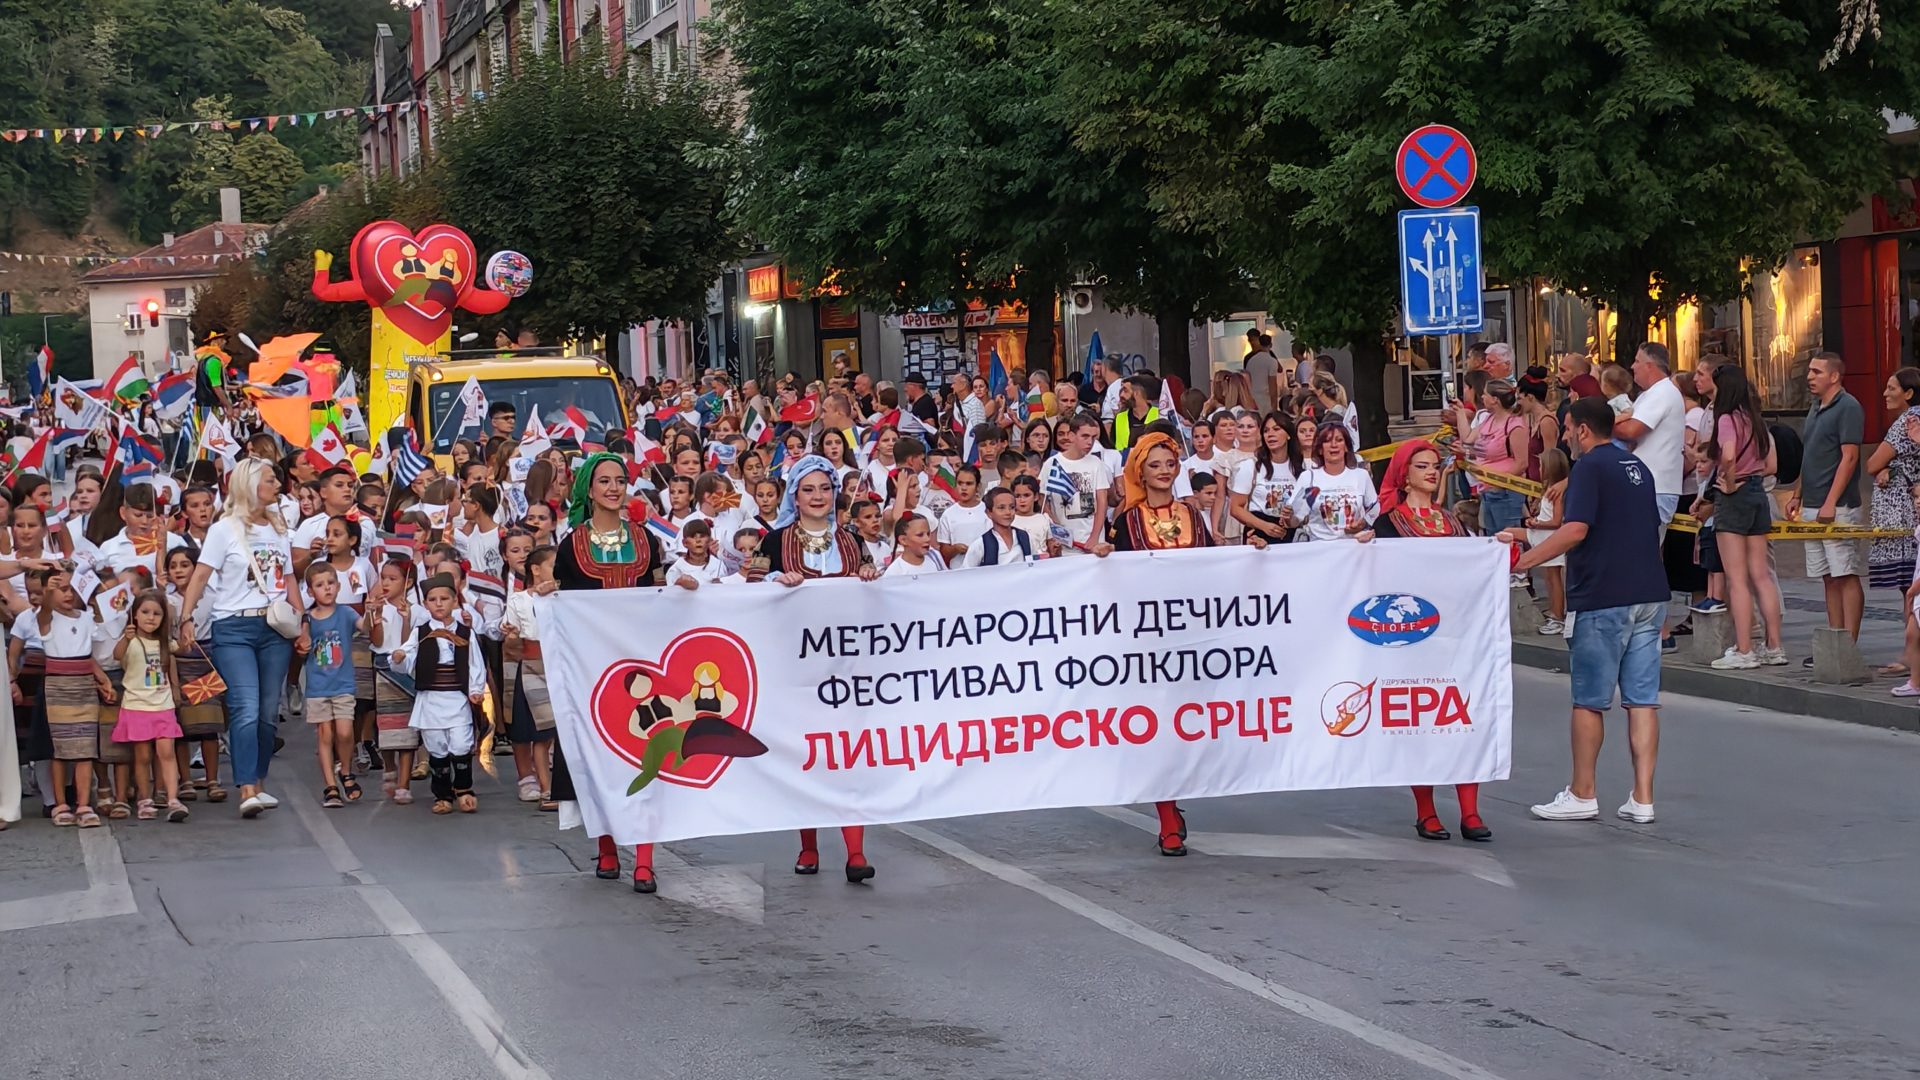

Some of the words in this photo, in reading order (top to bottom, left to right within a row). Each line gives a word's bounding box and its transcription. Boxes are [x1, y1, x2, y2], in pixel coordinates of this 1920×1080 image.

[799, 601, 1122, 658] МЕЂУНАРОДНИ
[1133, 593, 1293, 639] ДЕЧИЈИ
[1371, 622, 1417, 632] CIOFF
[817, 661, 1043, 709] ФЕСТИВАЛ
[1054, 645, 1278, 690] ФОЛКЛОРА
[1381, 685, 1472, 728] ЕРА
[803, 705, 1159, 771] ЛИЦИДЕРСКО
[1173, 696, 1293, 743] СРЦЕ
